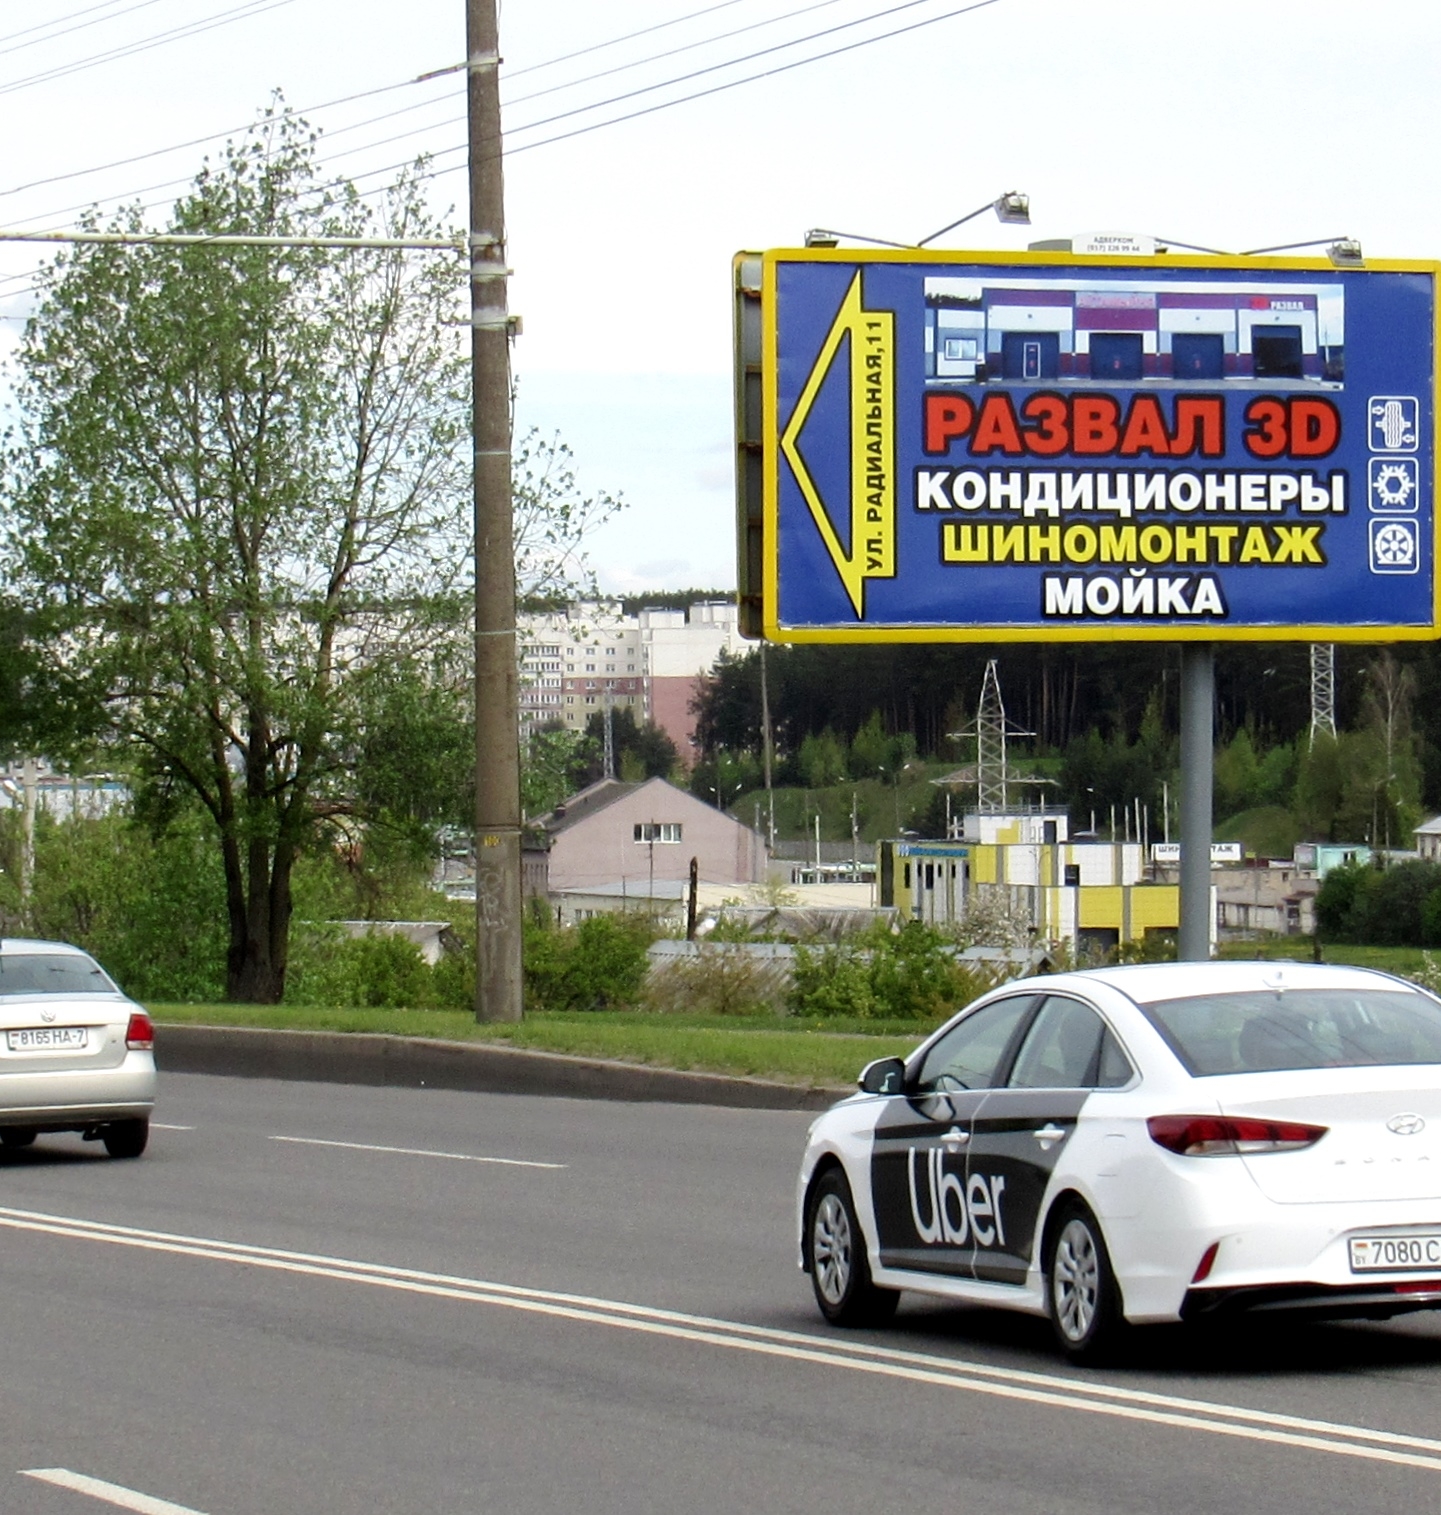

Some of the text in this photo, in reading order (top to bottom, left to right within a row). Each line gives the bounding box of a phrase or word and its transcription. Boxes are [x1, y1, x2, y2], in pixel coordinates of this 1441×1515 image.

[866, 321, 886, 571] УЛ. РАДИАЛЬНАЯ,11
[924, 395, 1339, 457] РАЗВАЛ 3D
[916, 470, 1345, 518] КОНДИЦИОНЕРЫ
[943, 524, 1324, 564] ШИНОМОНТАЖ
[1044, 567, 1225, 615] МОЙКА
[20, 1029, 84, 1045] 8165 HA-7
[907, 1146, 1006, 1247] Uber
[1371, 1240, 1422, 1264] 7080
